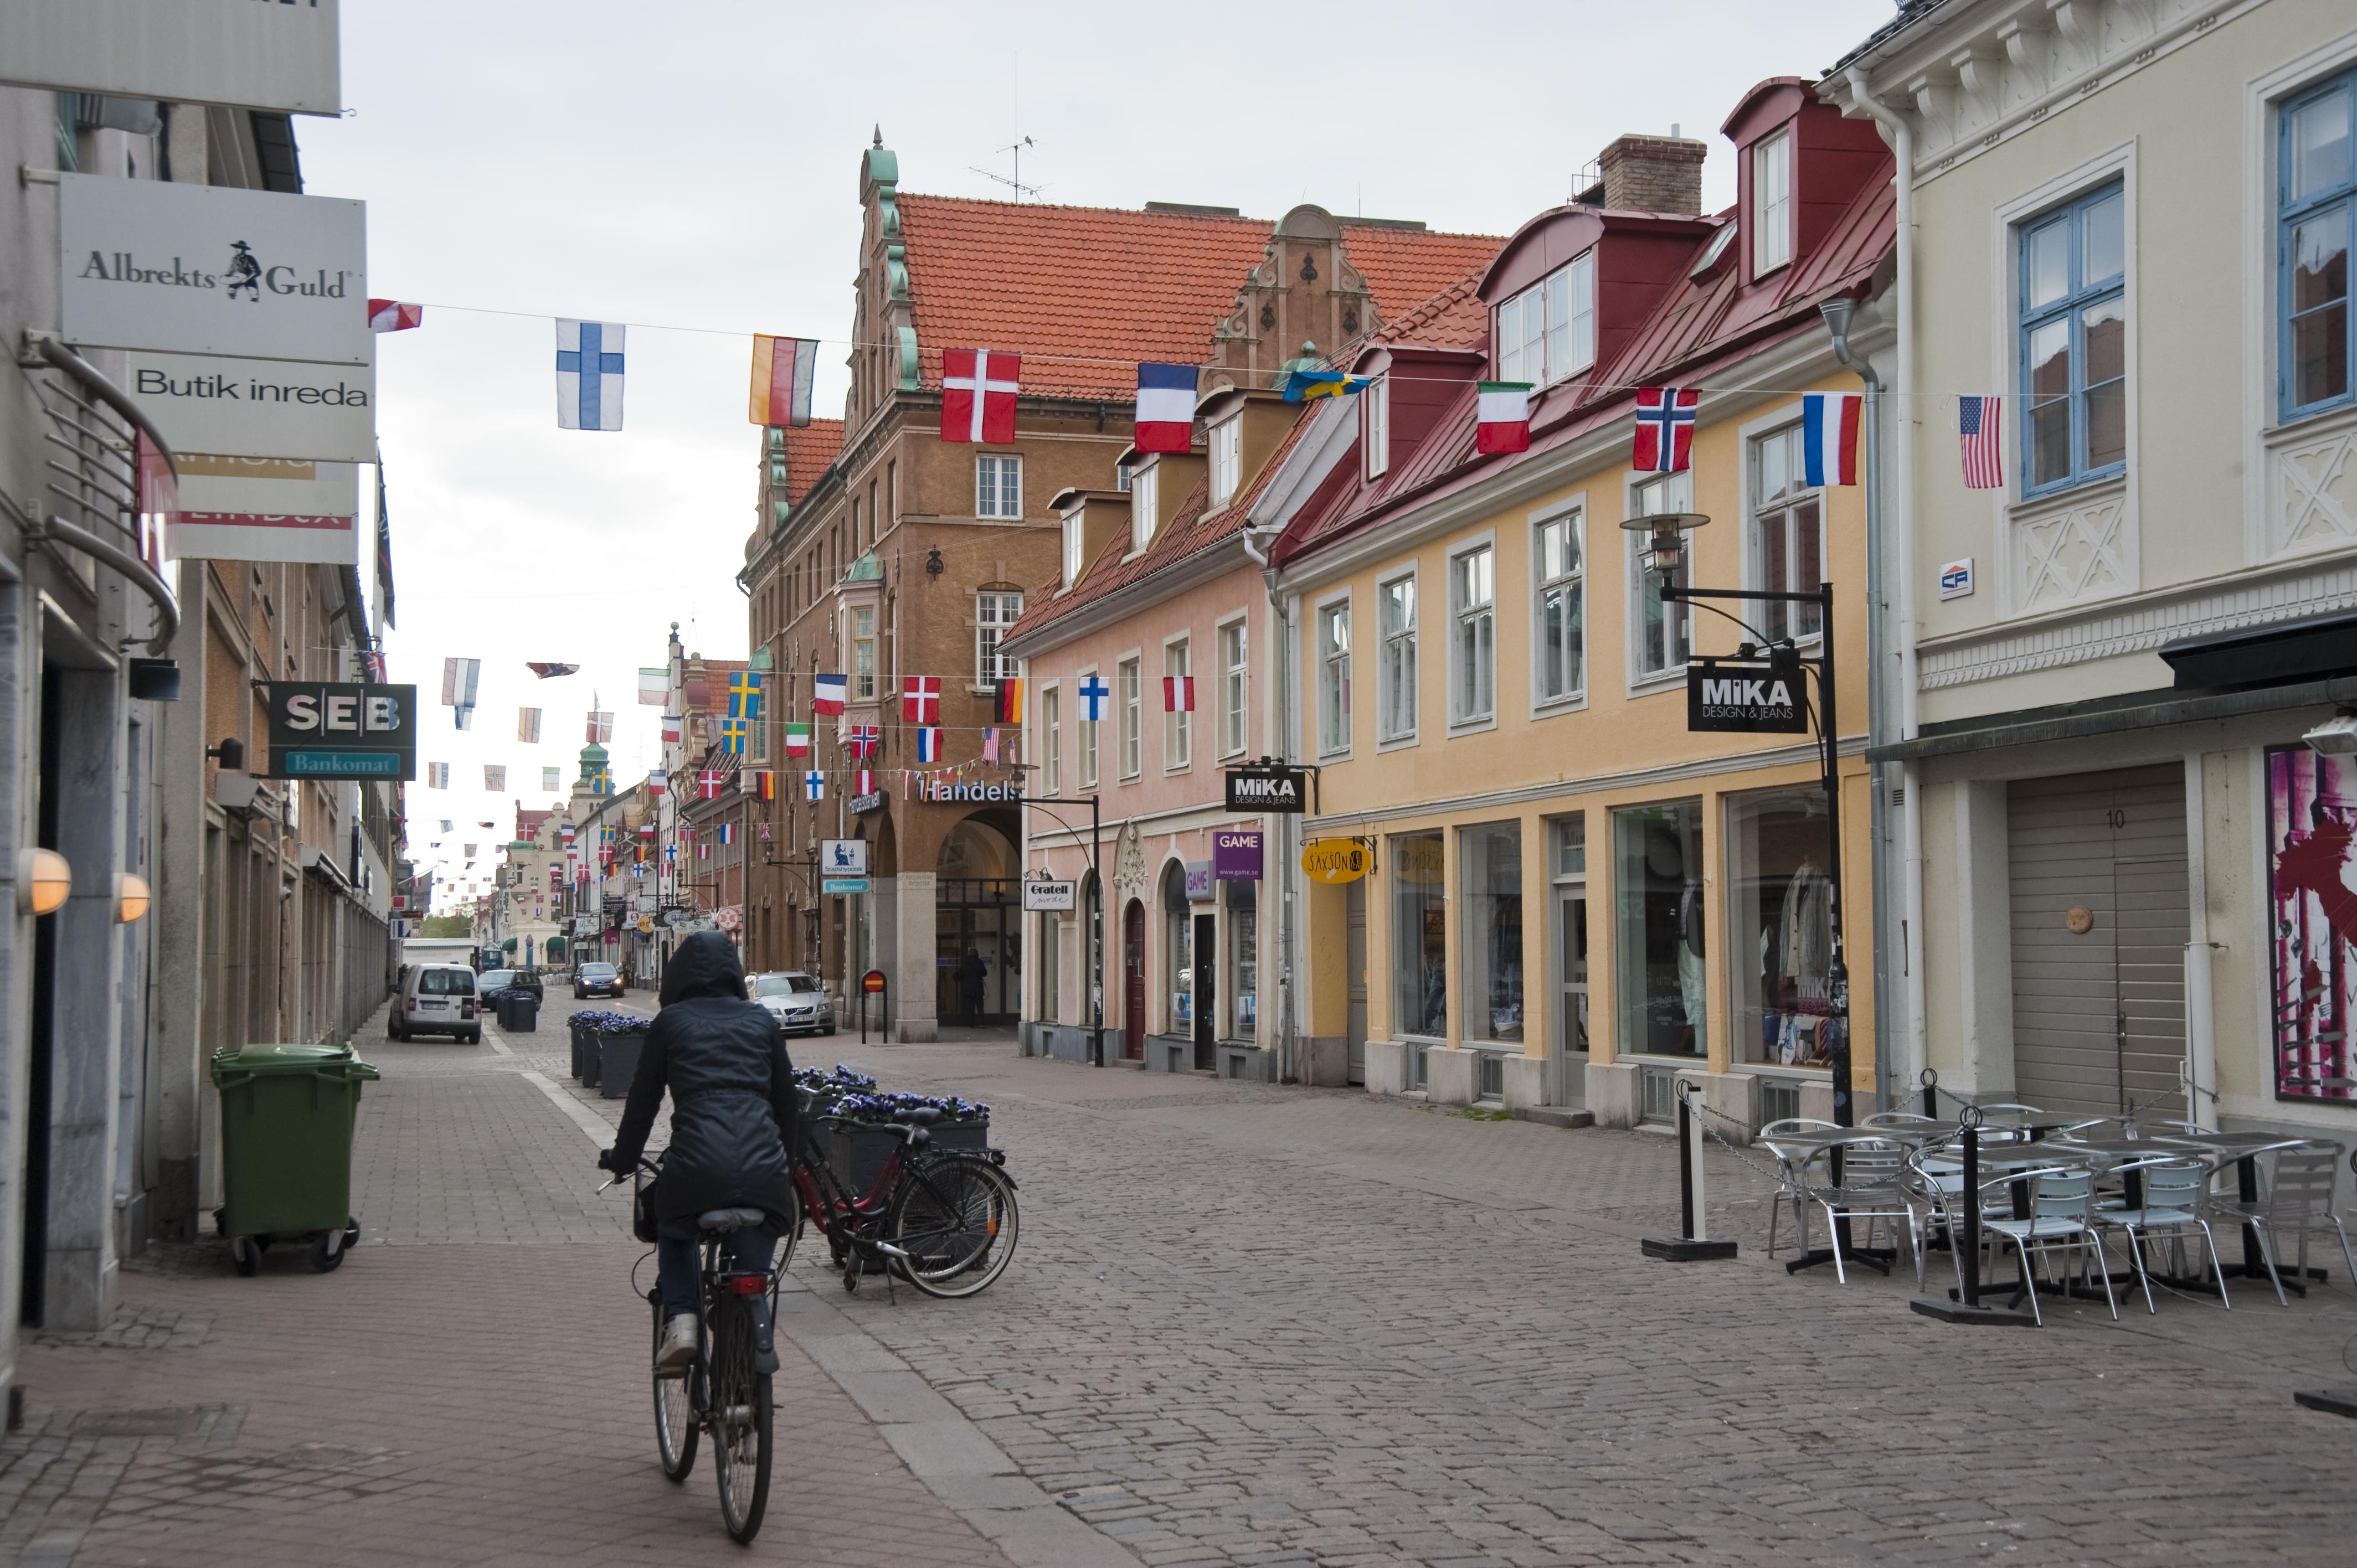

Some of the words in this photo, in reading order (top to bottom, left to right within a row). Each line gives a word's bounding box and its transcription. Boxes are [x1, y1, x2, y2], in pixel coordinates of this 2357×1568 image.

[79, 250, 217, 289] Albrekts
[265, 266, 346, 298] Guld
[137, 369, 240, 400] Butik
[250, 379, 368, 407] inreda
[285, 694, 400, 731] SEB
[1702, 706, 1746, 718] DESIGN
[1748, 706, 1757, 719] &
[1758, 706, 1794, 720] JEANS
[295, 754, 391, 772] Bankomat
[1235, 796, 1264, 804] DESIGN
[1266, 796, 1272, 804] &
[1273, 796, 1296, 805] JEANS
[2107, 809, 2125, 829] 10
[1219, 835, 1258, 848] GAME
[1308, 852, 1348, 873] SAXSON
[1031, 885, 1068, 895] Gratell
[1187, 870, 1207, 891] GAME
